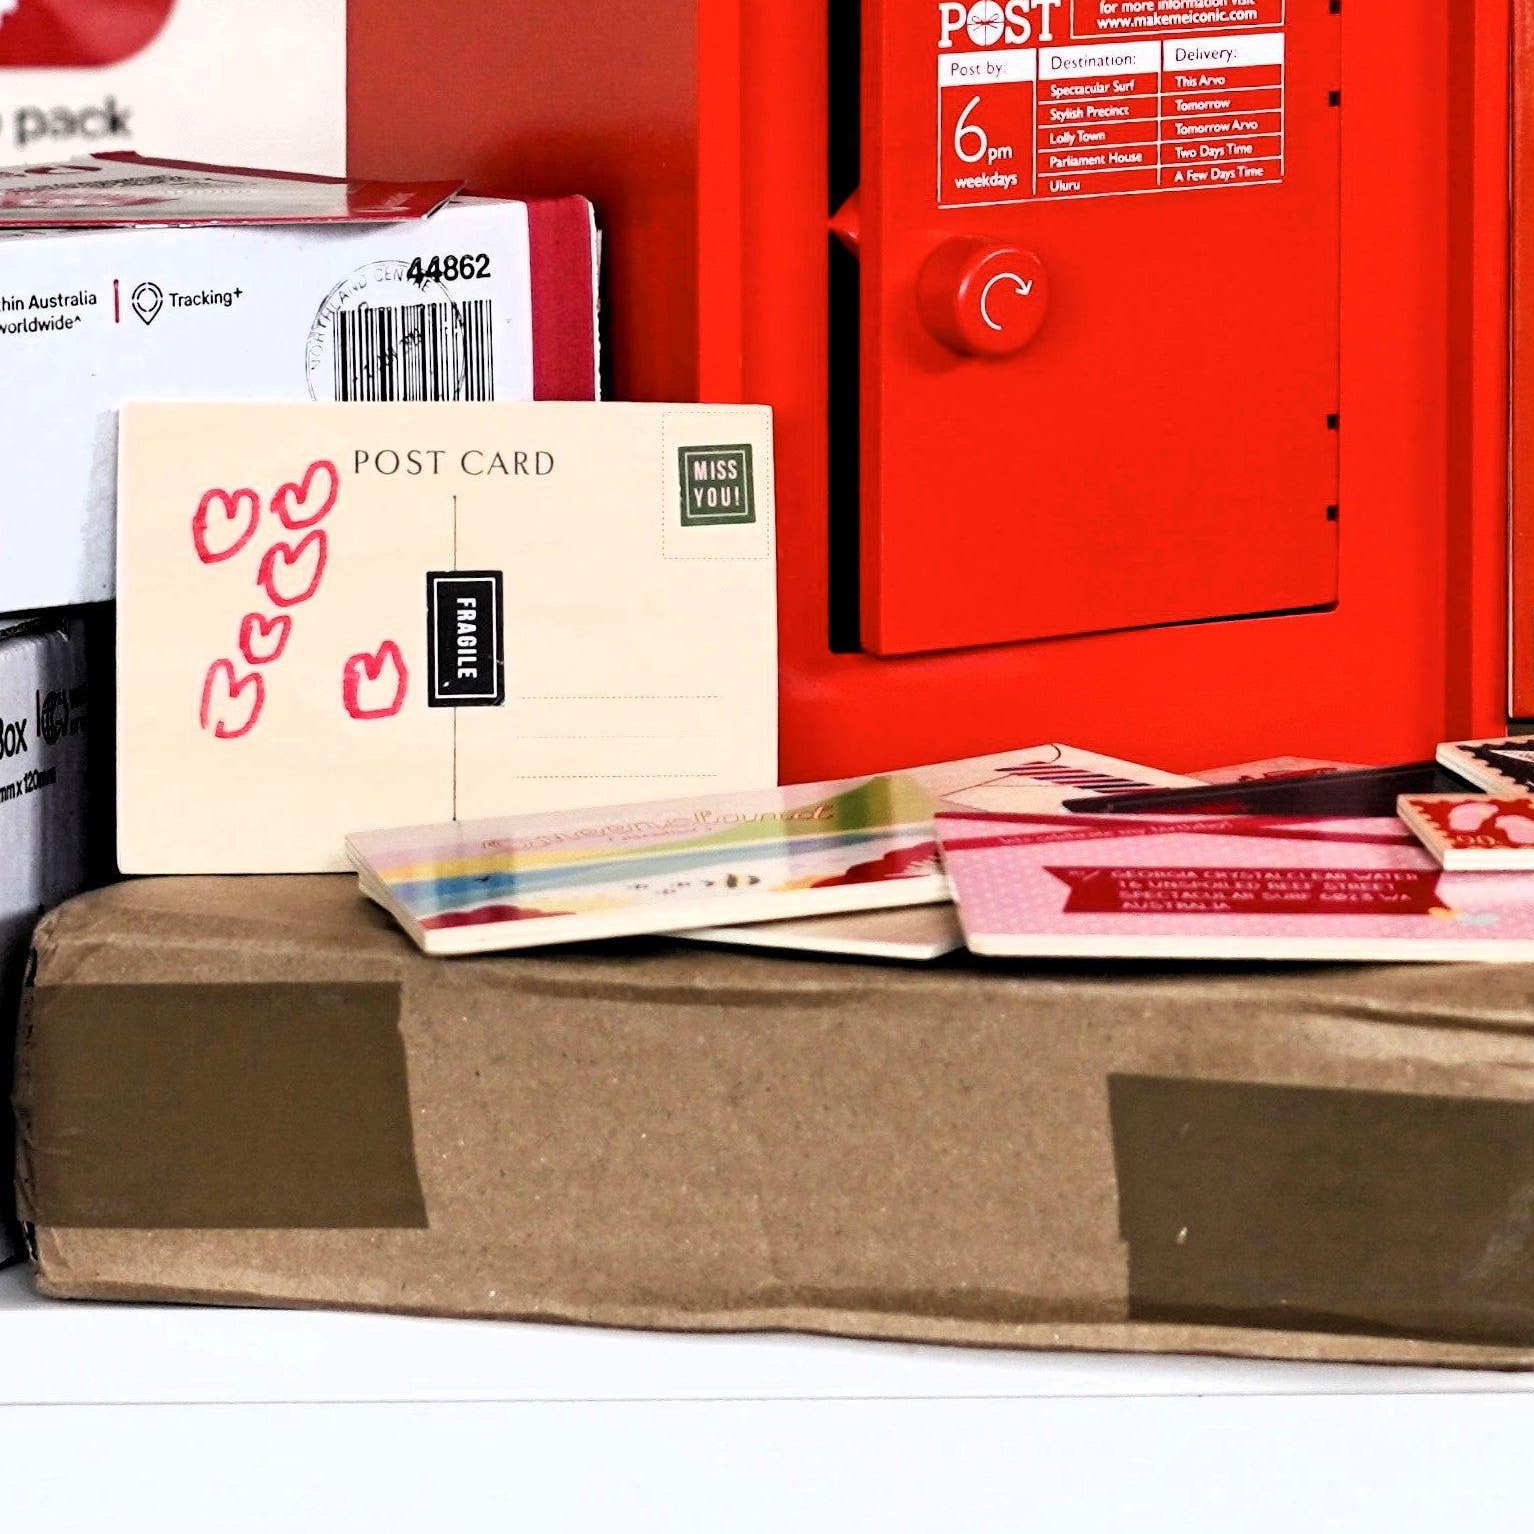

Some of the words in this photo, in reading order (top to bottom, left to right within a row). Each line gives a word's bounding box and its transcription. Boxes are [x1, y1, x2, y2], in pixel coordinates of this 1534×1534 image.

[1099, 0, 1119, 15] for
[1121, 0, 1154, 13] more
[1096, 7, 1258, 31] www.makemeiconic.com
[1051, 52, 1137, 72] Destination:
[1175, 46, 1238, 65] Delivery:
[950, 62, 981, 77] Post
[986, 60, 1008, 77] by:
[1050, 80, 1110, 99] Spectacular
[1112, 78, 1136, 95] Surf
[1175, 74, 1196, 89] This
[1198, 72, 1226, 87] Arvo
[1050, 106, 1084, 122] Stylish
[1086, 103, 1129, 118] Precinct
[1175, 97, 1231, 112] Tomorrow
[14, 96, 132, 149] pack
[1175, 121, 1229, 137] Tomorrow
[1231, 118, 1259, 133] Arvo
[1049, 129, 1076, 147] Lolly
[1078, 129, 1107, 143] Town
[1049, 151, 1106, 168] Parliament
[1108, 149, 1143, 165] House
[1175, 146, 1198, 160] Two
[1199, 144, 1226, 160] Days
[1226, 141, 1253, 157] Time
[955, 171, 1018, 190] weekdays
[1174, 171, 1184, 183] A
[1186, 168, 1207, 183] Few
[1209, 165, 1236, 183] Days
[1237, 165, 1264, 178] Time
[1049, 178, 1081, 194] Uluru
[406, 253, 492, 283] 44862
[28, 289, 98, 310] Australia
[353, 449, 446, 476] POST
[461, 450, 556, 477] CARD
[694, 459, 739, 482] MISS
[694, 487, 741, 509] YOU!
[456, 597, 478, 680] FRAGILE
